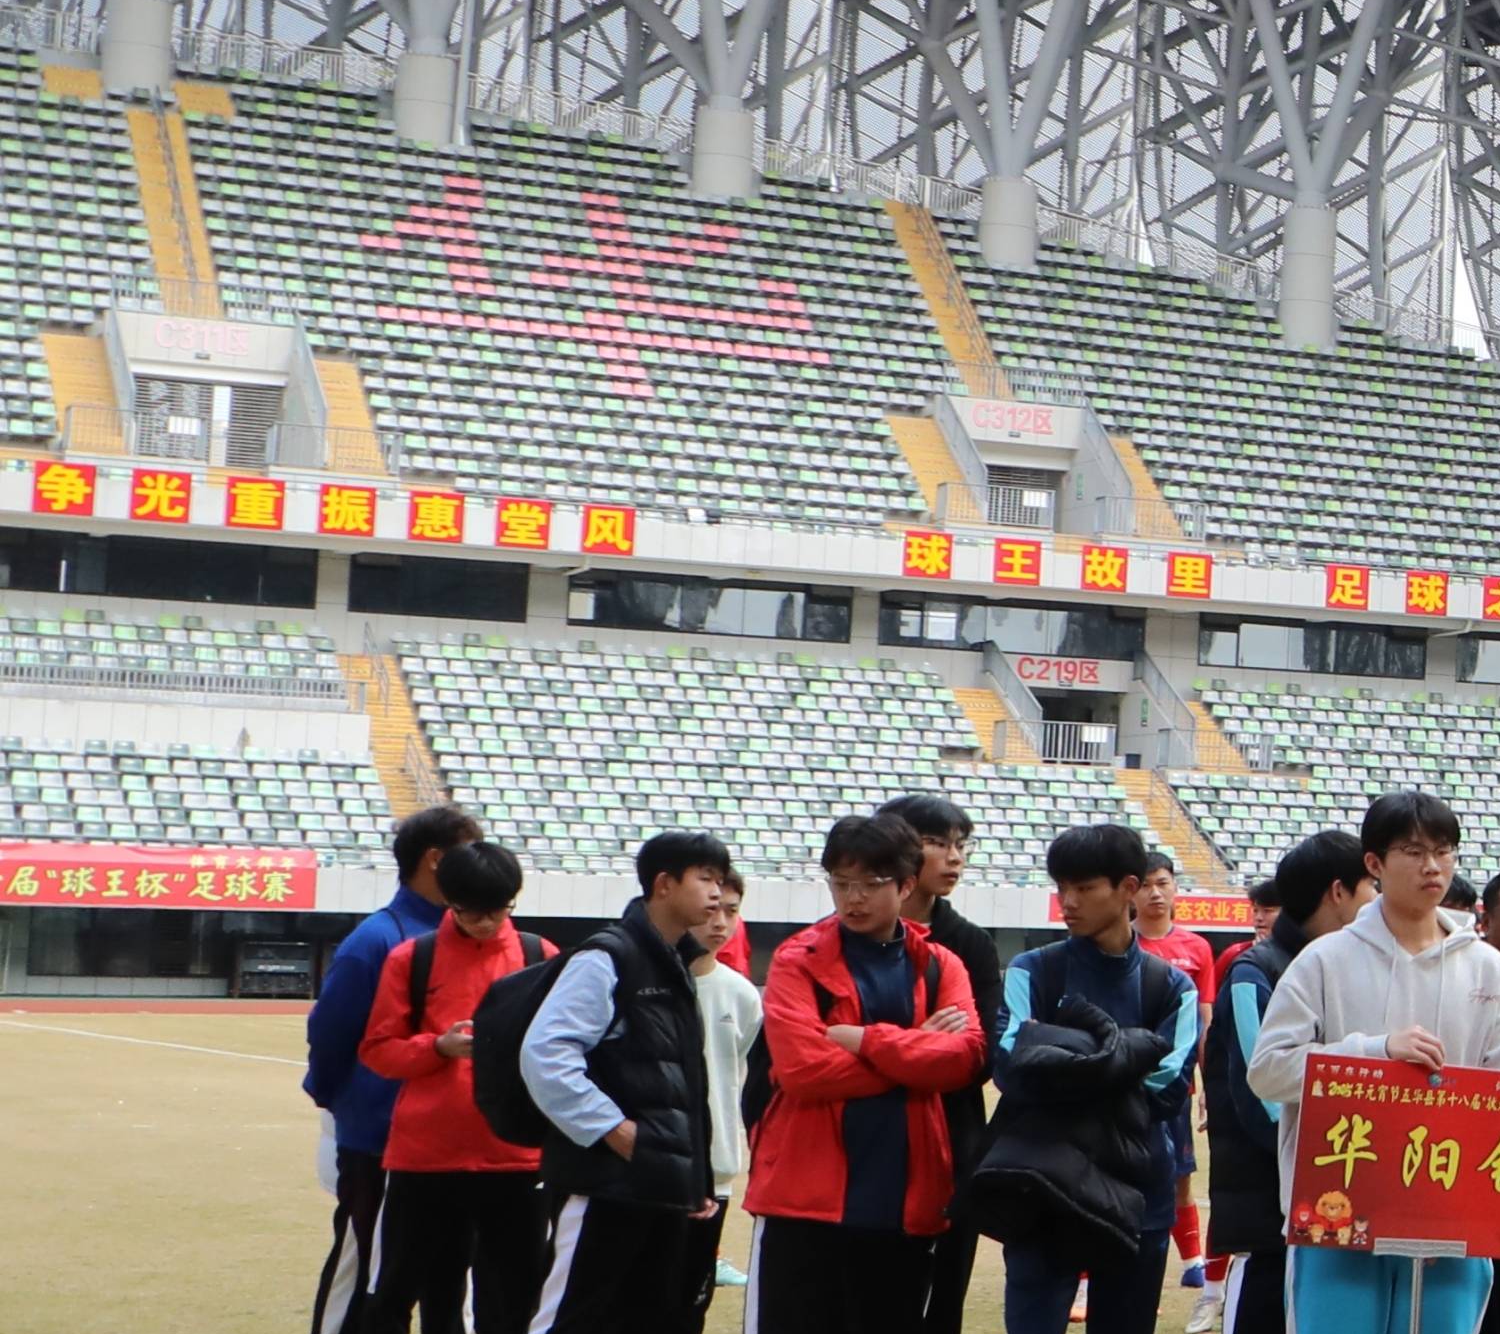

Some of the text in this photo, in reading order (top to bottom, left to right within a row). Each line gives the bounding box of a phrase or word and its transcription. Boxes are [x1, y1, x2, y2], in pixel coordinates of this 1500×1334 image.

[971, 402, 1054, 436] C312区
[35, 464, 632, 555] 争光重振惠堂风
[904, 534, 1212, 599] 球王故里
[1017, 656, 1100, 684] C219区
[0, 865, 295, 904] 届“球王杯”足球赛
[1175, 899, 1251, 923] 态农业有
